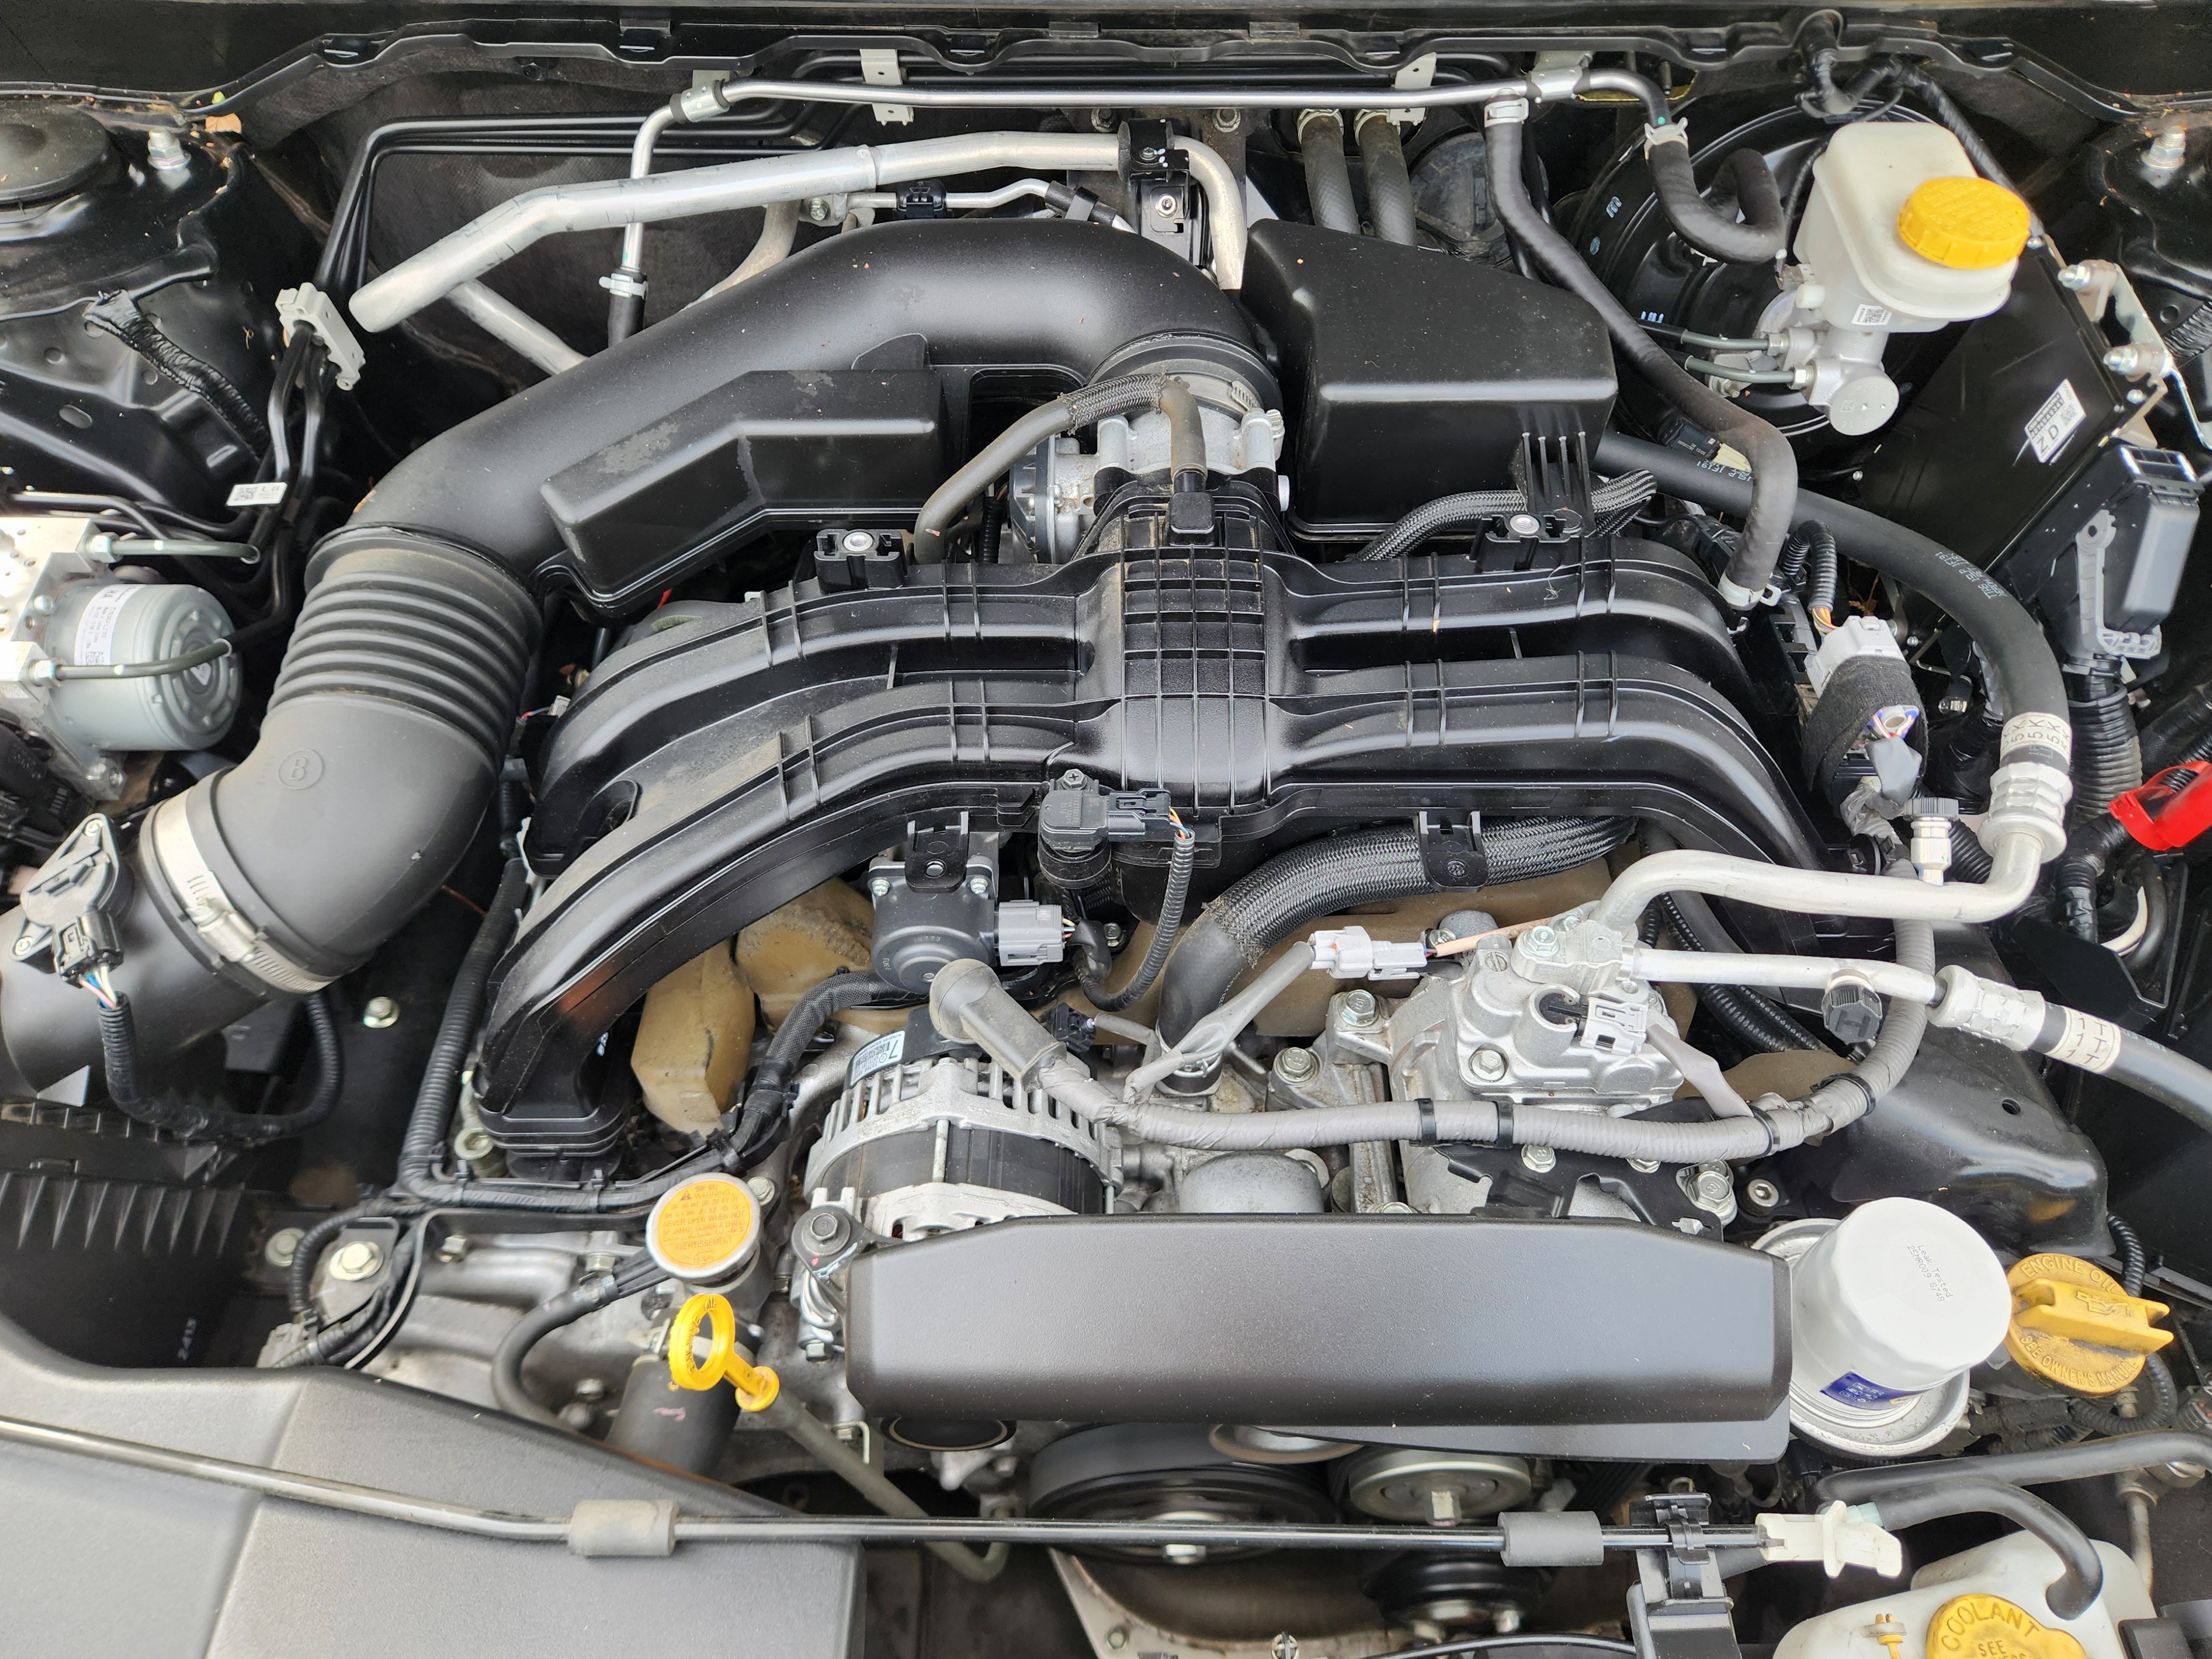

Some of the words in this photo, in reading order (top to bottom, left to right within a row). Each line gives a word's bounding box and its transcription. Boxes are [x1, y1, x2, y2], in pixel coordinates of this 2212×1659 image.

[888, 1040, 899, 1060] 7
[694, 1190, 731, 1199] WARNING
[664, 1218, 686, 1227] NEVER
[687, 1216, 706, 1224] OPEN
[708, 1213, 729, 1222] WHEN
[675, 1237, 733, 1250] AVERTISSEMENT
[1917, 1244, 1933, 1264] Leak
[1932, 1267, 1954, 1297] Tested
[2020, 1255, 2085, 1279] ENGINE
[2089, 1269, 2116, 1293] OIL
[1929, 1282, 1945, 1302] 8748
[703, 1297, 717, 1311] OIL
[2020, 1334, 2044, 1359] SEE
[2042, 1355, 2096, 1387] OWNER'S
[2095, 1357, 2139, 1387] MANUAL
[1941, 1601, 2040, 1652] COOLANT
[1977, 1639, 2007, 1658] SEE
